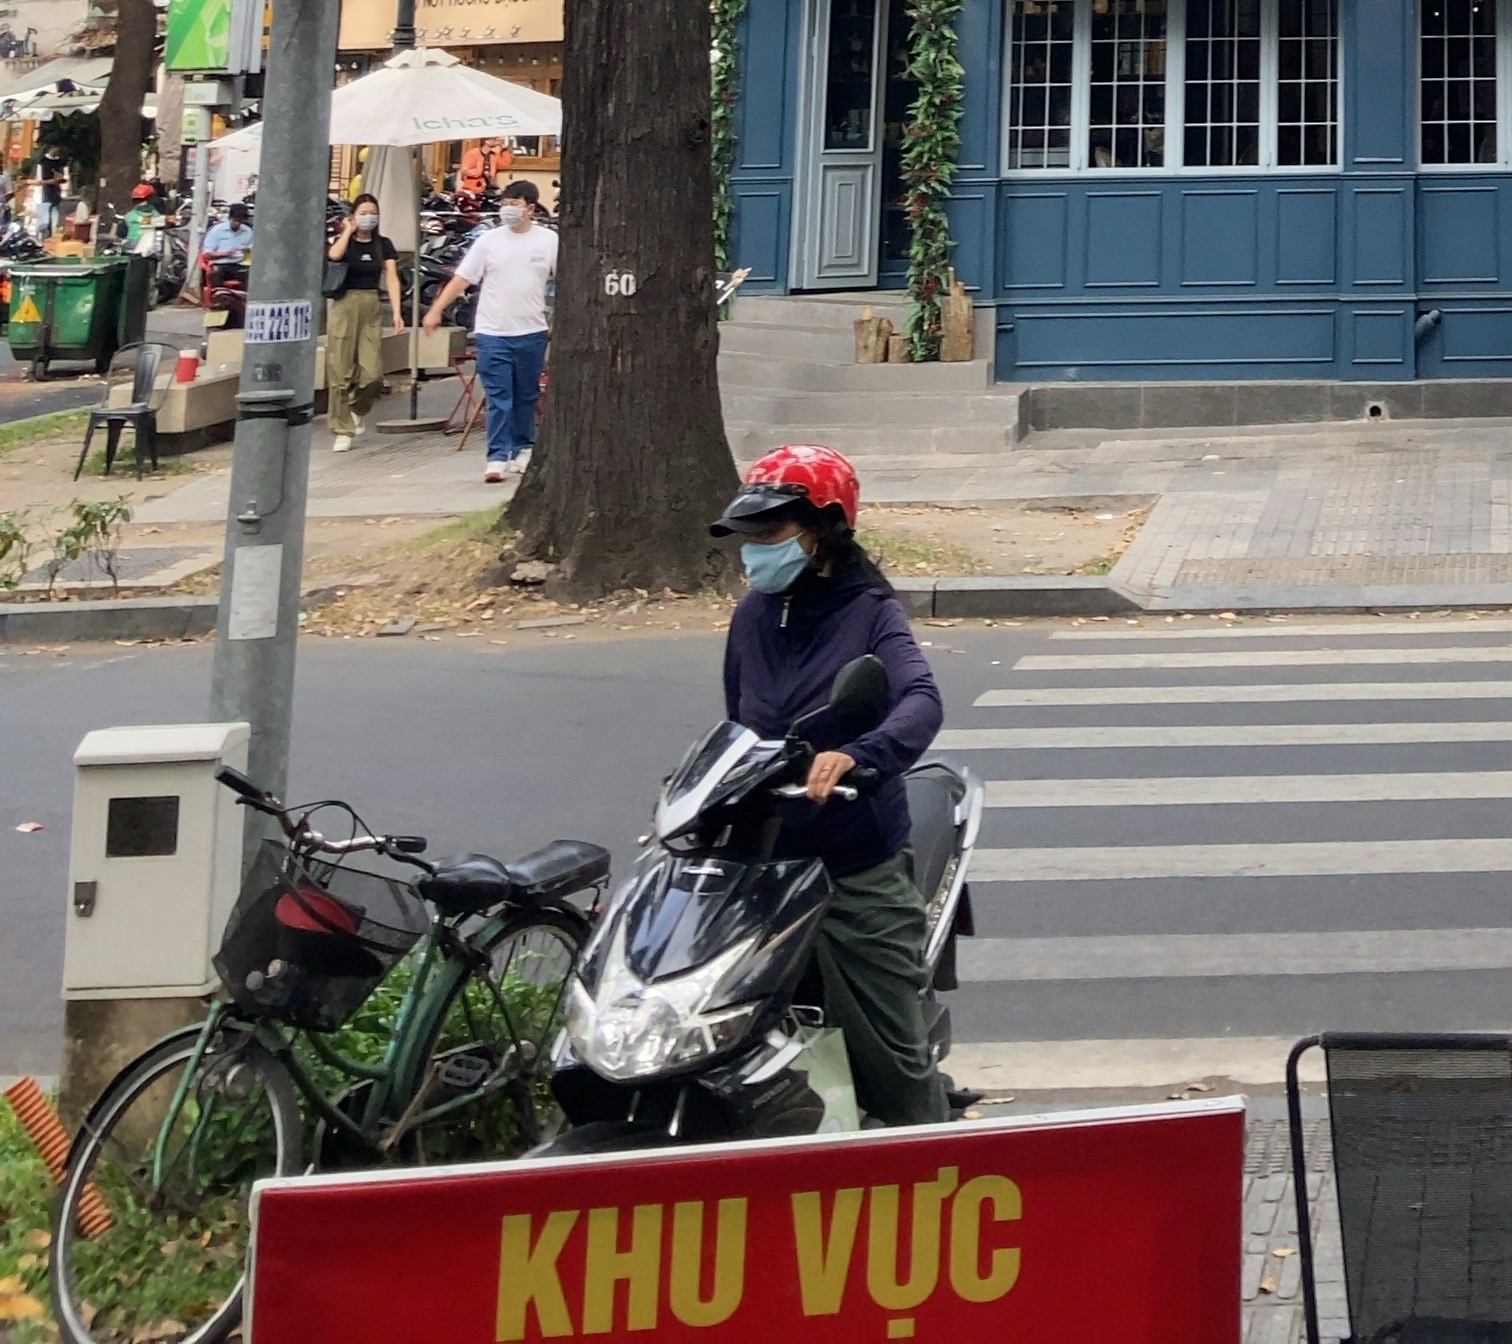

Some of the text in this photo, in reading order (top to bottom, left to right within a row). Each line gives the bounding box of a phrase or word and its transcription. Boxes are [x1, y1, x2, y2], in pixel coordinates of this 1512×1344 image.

[605, 273, 637, 296] 60
[495, 1165, 1022, 1342] KHU VỰC
